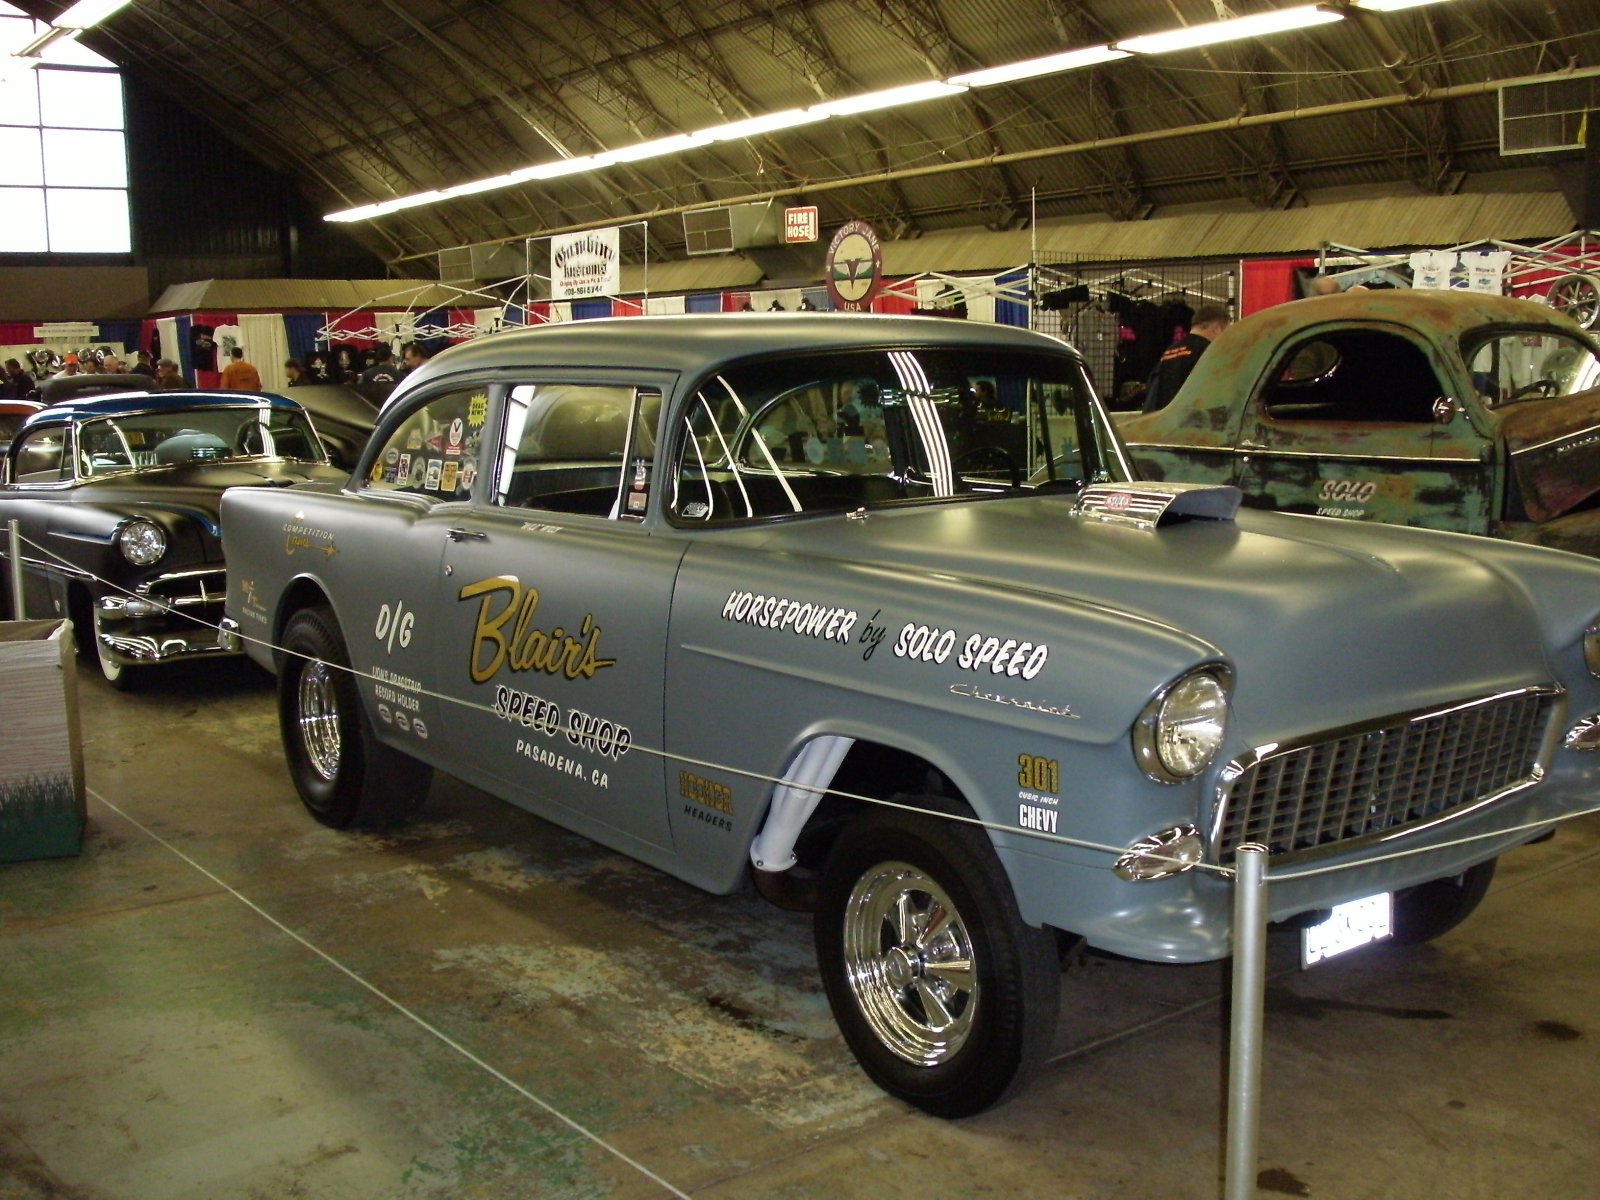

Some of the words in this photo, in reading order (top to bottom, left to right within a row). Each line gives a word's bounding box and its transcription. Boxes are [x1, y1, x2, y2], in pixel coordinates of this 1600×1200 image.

[787, 225, 809, 238] HOSE
[788, 212, 808, 224] FIRE
[829, 223, 860, 254] VICTORY
[862, 226, 880, 252] JANE
[844, 302, 862, 312] USA
[1319, 479, 1377, 503] SOLO
[1316, 507, 1341, 517] SPEED
[1342, 509, 1365, 518] SHOP
[282, 523, 336, 541] COMPETITION
[375, 600, 415, 654] D/G
[459, 574, 617, 684] Blair's
[721, 589, 858, 645] HORSEPOWER
[858, 609, 886, 661] by
[893, 622, 957, 665] SOLO
[958, 632, 1049, 681] SPEED
[375, 684, 396, 703] RECORD
[397, 693, 420, 712] HOLDER
[491, 684, 561, 737] SPEED
[566, 708, 632, 762] SHOP
[591, 769, 608, 790] CA
[1018, 753, 1059, 794] 301
[1018, 791, 1039, 802] CUBIC
[1040, 796, 1059, 806] INCH
[683, 804, 733, 832] HEADERS
[1019, 803, 1058, 834] CHEVY
